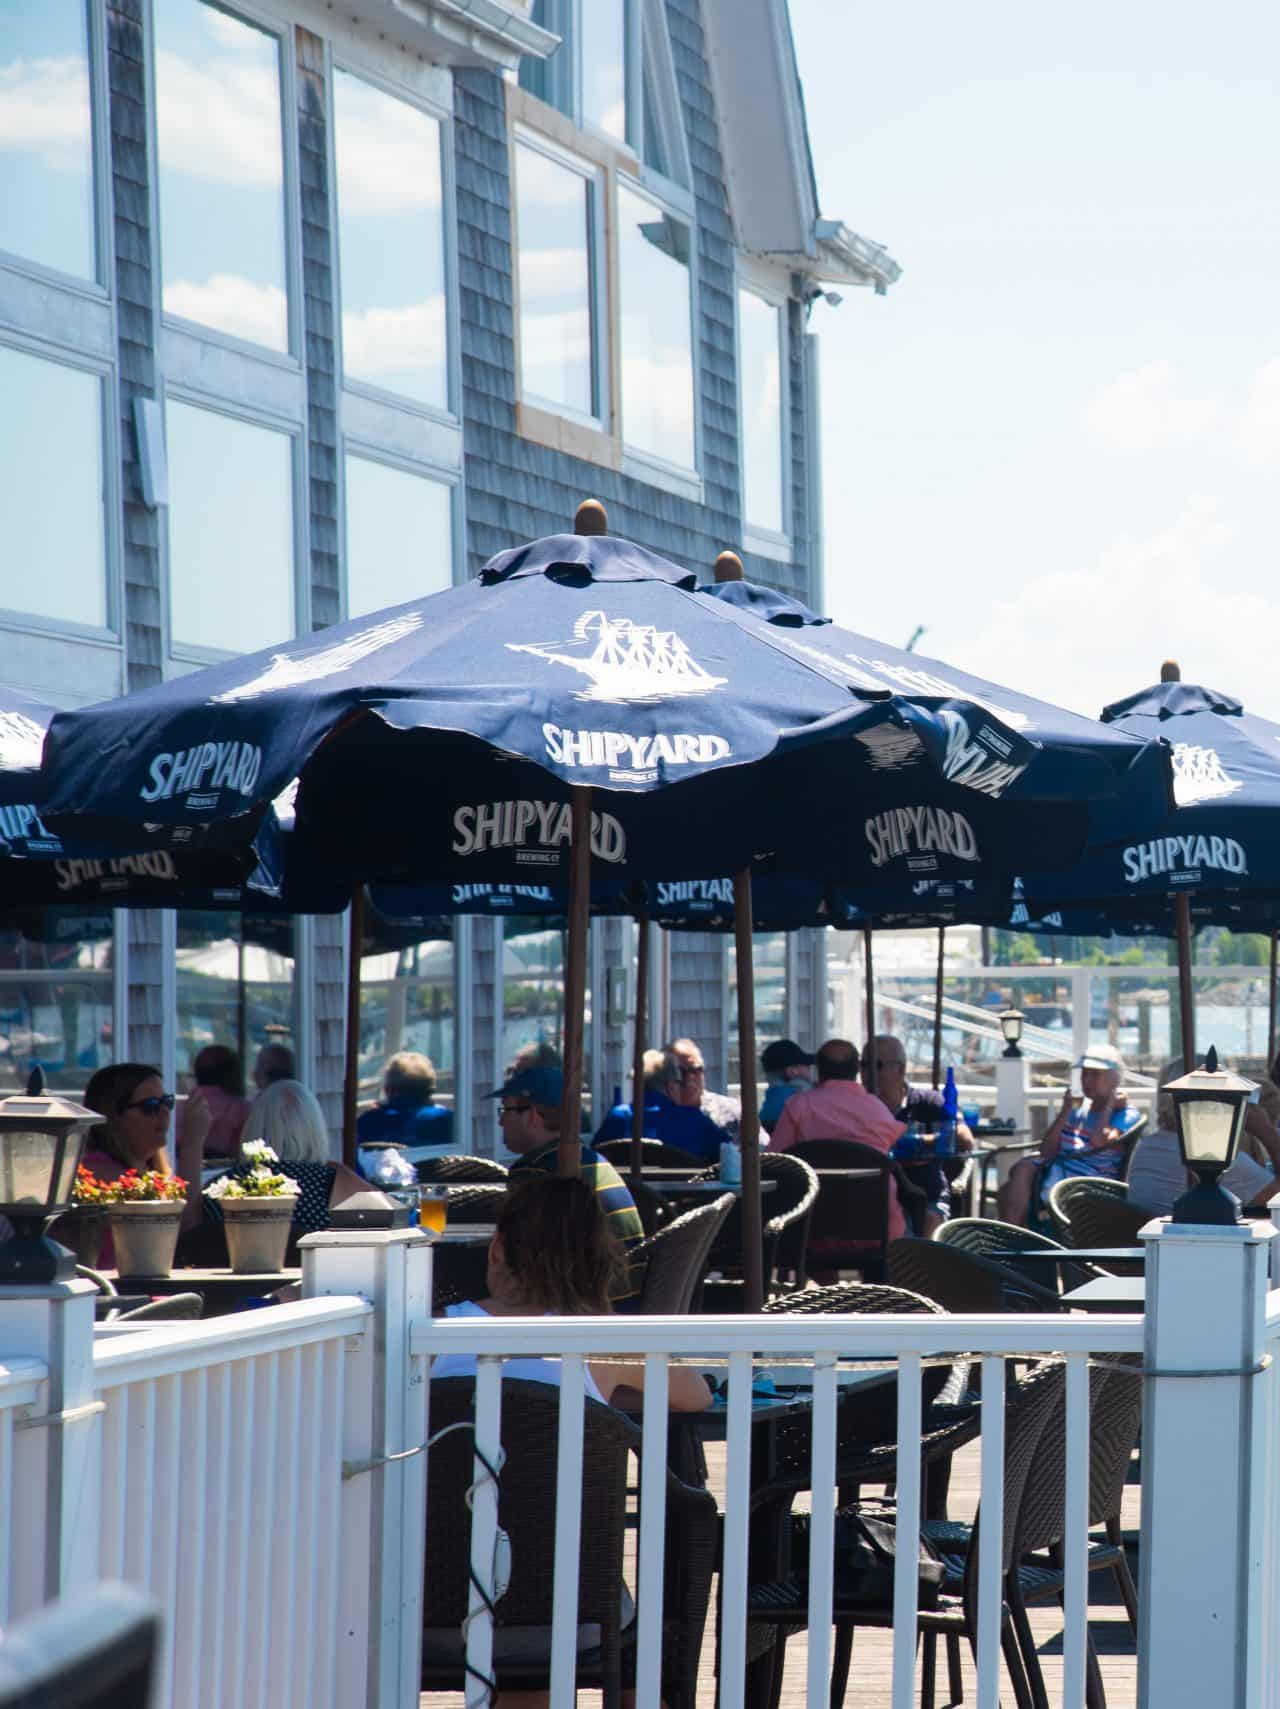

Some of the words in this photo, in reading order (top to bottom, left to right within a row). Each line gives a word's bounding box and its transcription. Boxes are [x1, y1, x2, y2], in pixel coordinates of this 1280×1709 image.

[140, 740, 262, 802] SHIPYARD
[542, 722, 731, 768] SHIPYARD
[865, 806, 980, 867] SHIPYARD
[1123, 835, 1248, 883] SHIPYARD
